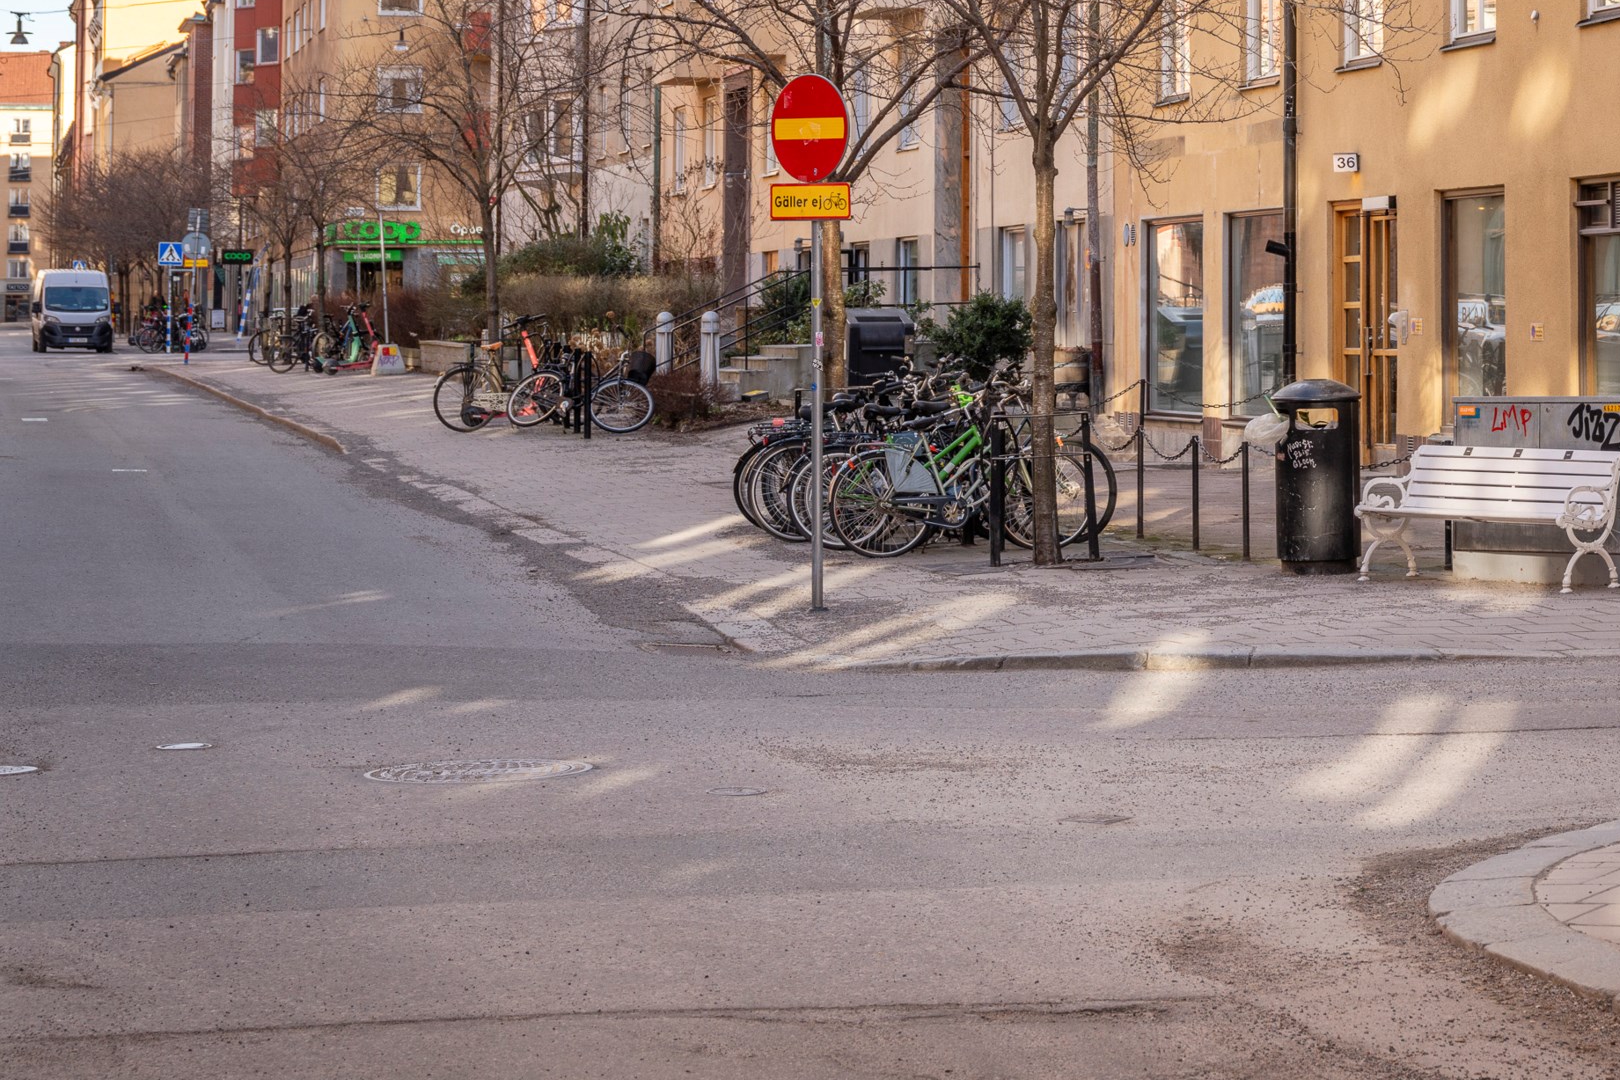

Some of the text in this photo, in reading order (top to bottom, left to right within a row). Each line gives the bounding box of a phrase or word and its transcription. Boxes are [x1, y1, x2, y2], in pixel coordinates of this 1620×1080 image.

[1337, 156, 1356, 169] 36
[774, 195, 822, 210] Gäller ej
[344, 221, 420, 243] coop
[224, 252, 251, 261] coop
[1491, 404, 1532, 437] LMP
